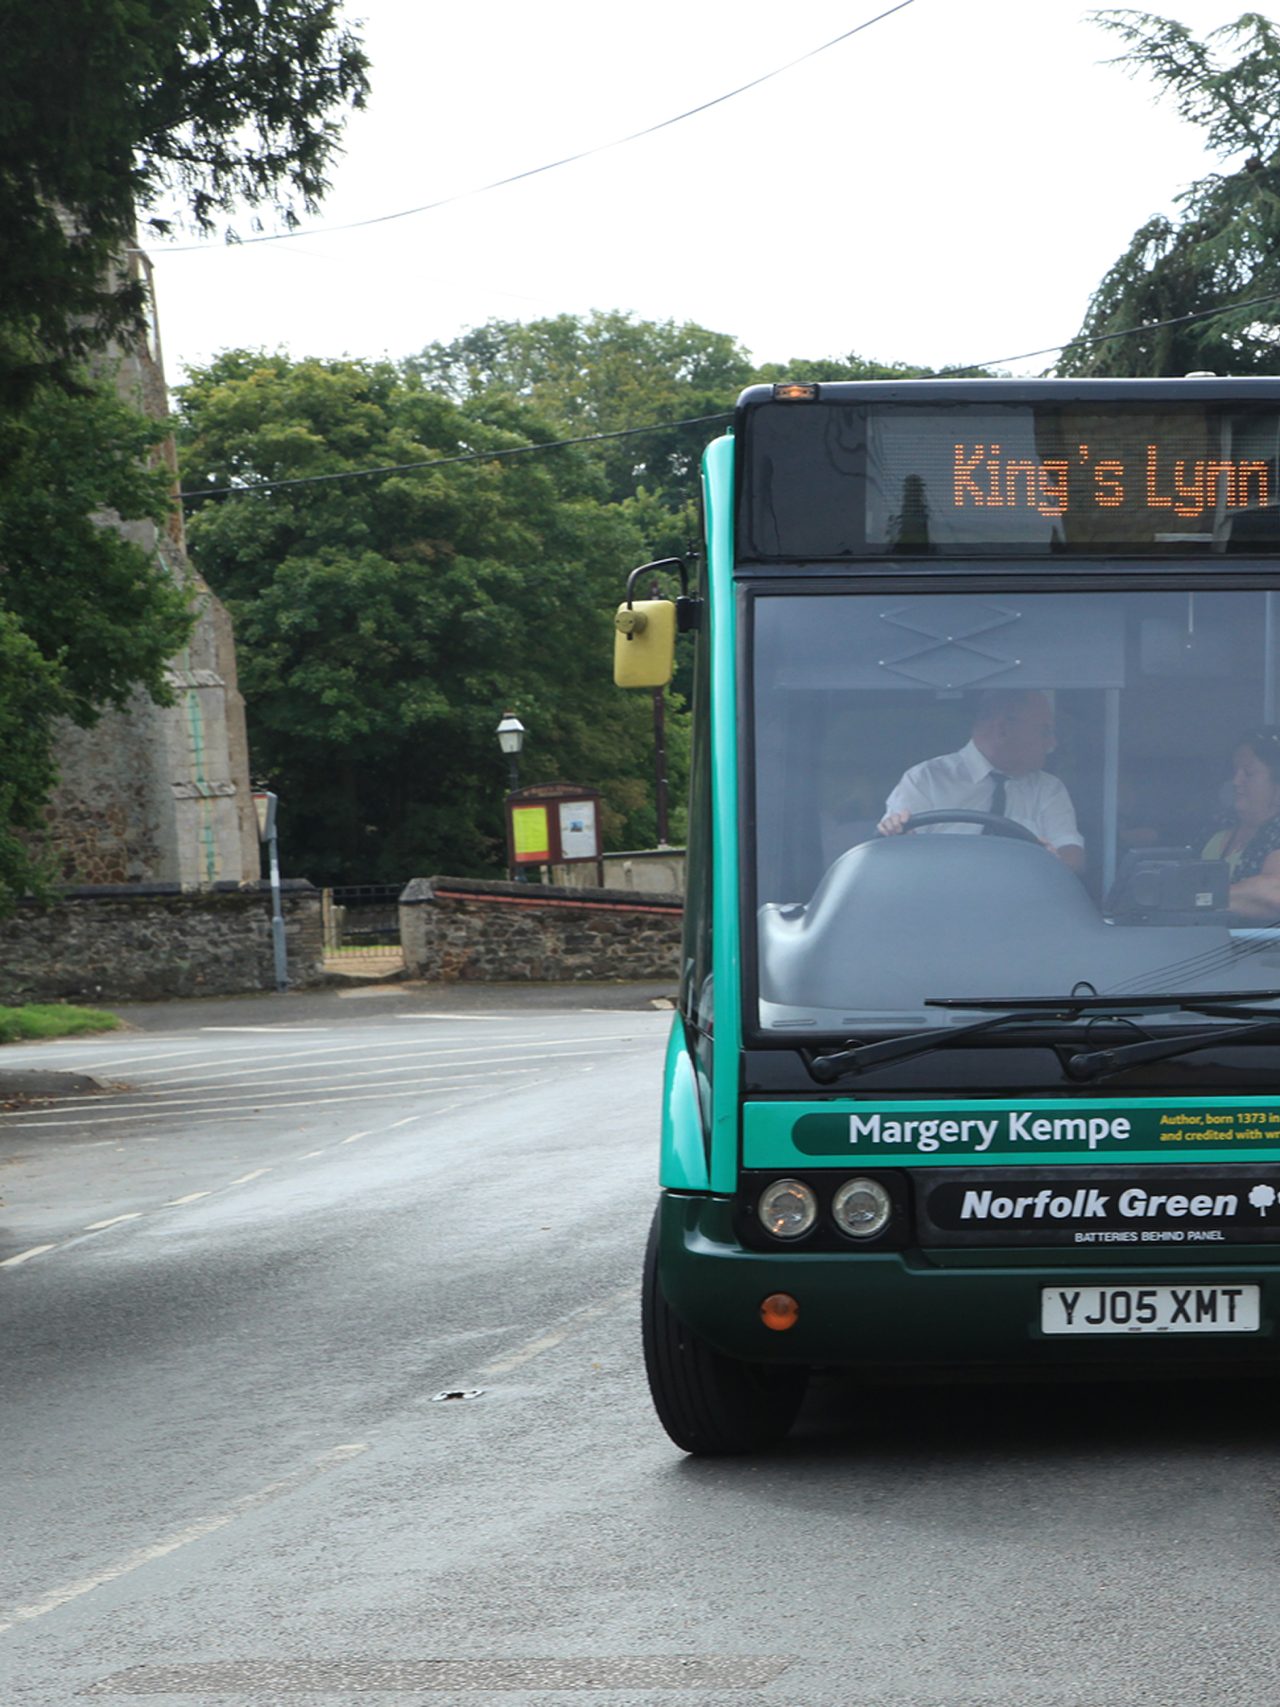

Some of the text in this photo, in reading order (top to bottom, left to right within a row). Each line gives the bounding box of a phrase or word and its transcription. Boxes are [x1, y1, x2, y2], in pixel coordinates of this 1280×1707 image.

[954, 444, 1268, 517] King's Lynn
[849, 1112, 1130, 1151] Margery Kempe
[1160, 1114, 1204, 1125] Author,
[1206, 1113, 1234, 1124] born
[1237, 1112, 1267, 1123] 1373
[1269, 1113, 1280, 1122] in
[1160, 1130, 1182, 1141] and
[1185, 1129, 1233, 1140] credited
[1235, 1129, 1262, 1139] with
[960, 1188, 1238, 1219] Norfolk Green
[1075, 1231, 1225, 1243] BATTERIES BEHIND PANEL
[1059, 1289, 1243, 1325] YJ05 XMT
